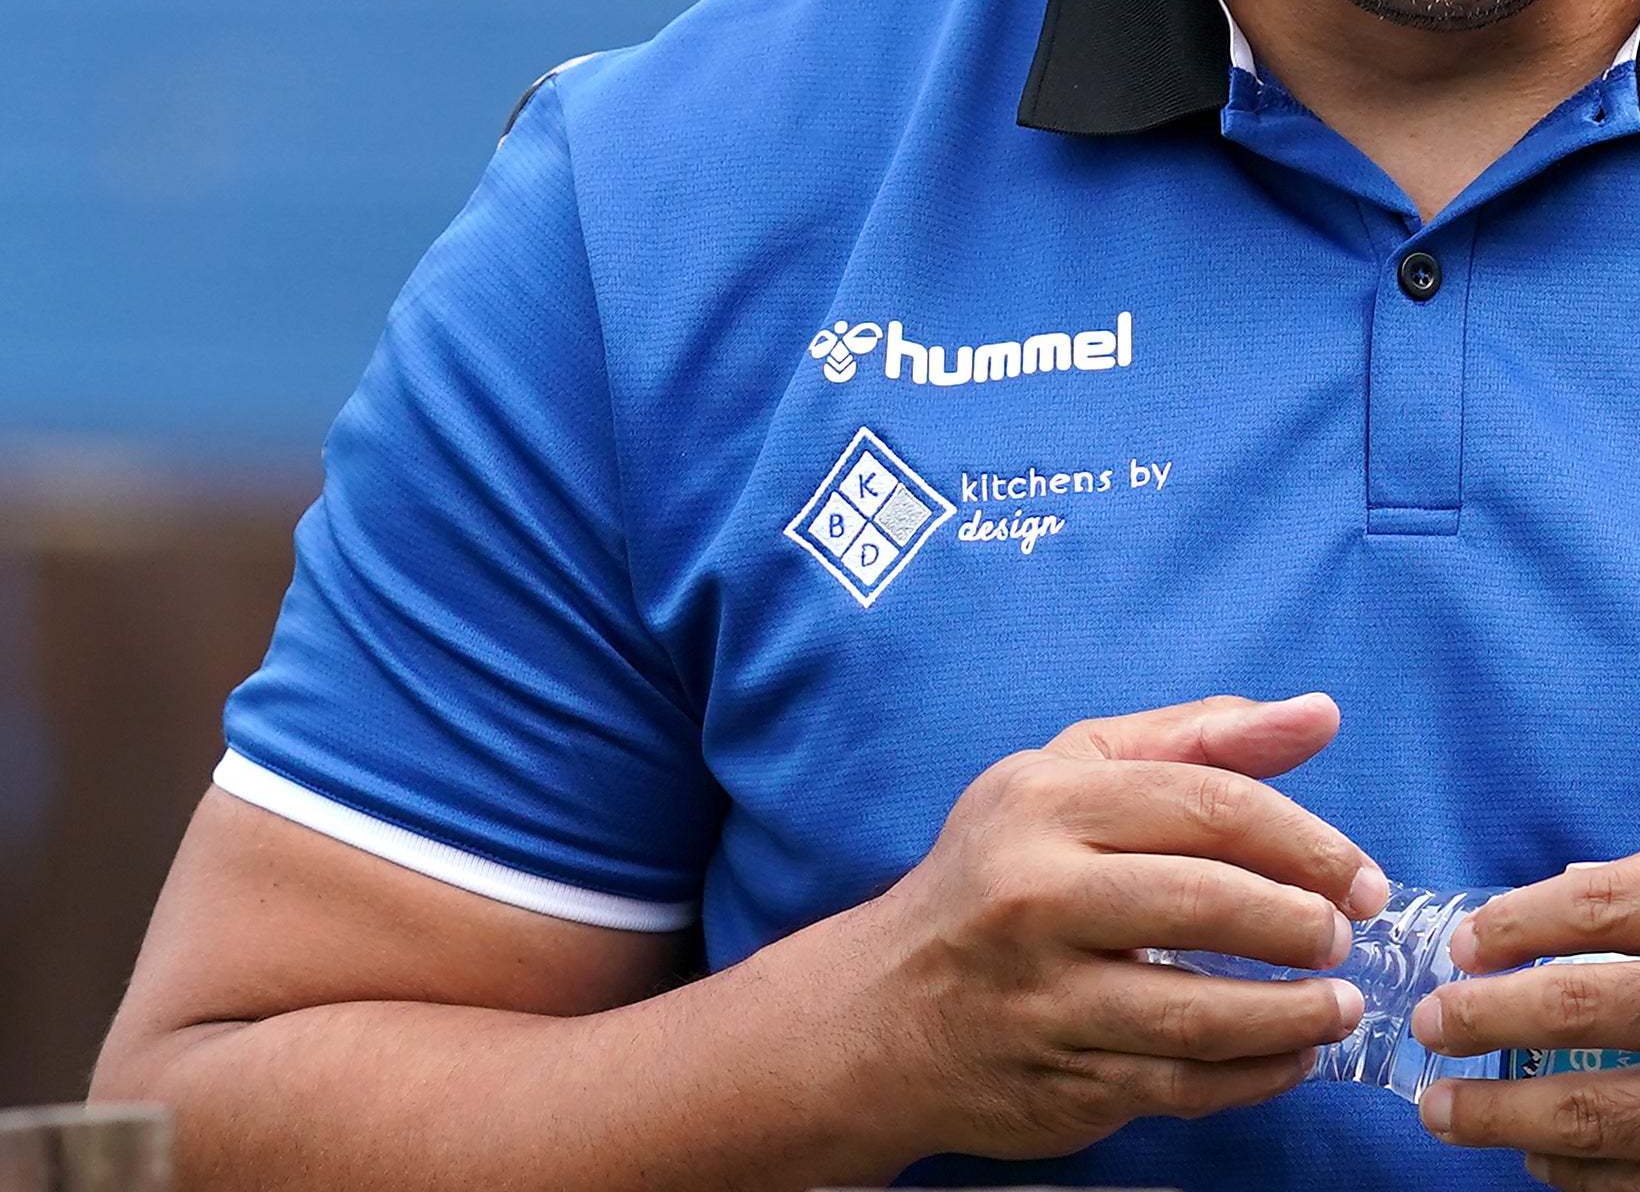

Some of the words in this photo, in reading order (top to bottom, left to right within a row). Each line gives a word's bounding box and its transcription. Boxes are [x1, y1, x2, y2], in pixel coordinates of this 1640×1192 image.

[884, 311, 1133, 387] hummel
[858, 472, 879, 499] K
[961, 467, 1113, 503] kitchens
[1130, 459, 1173, 490] by
[829, 514, 845, 539] B
[957, 510, 1066, 555] design
[861, 543, 880, 568] D
